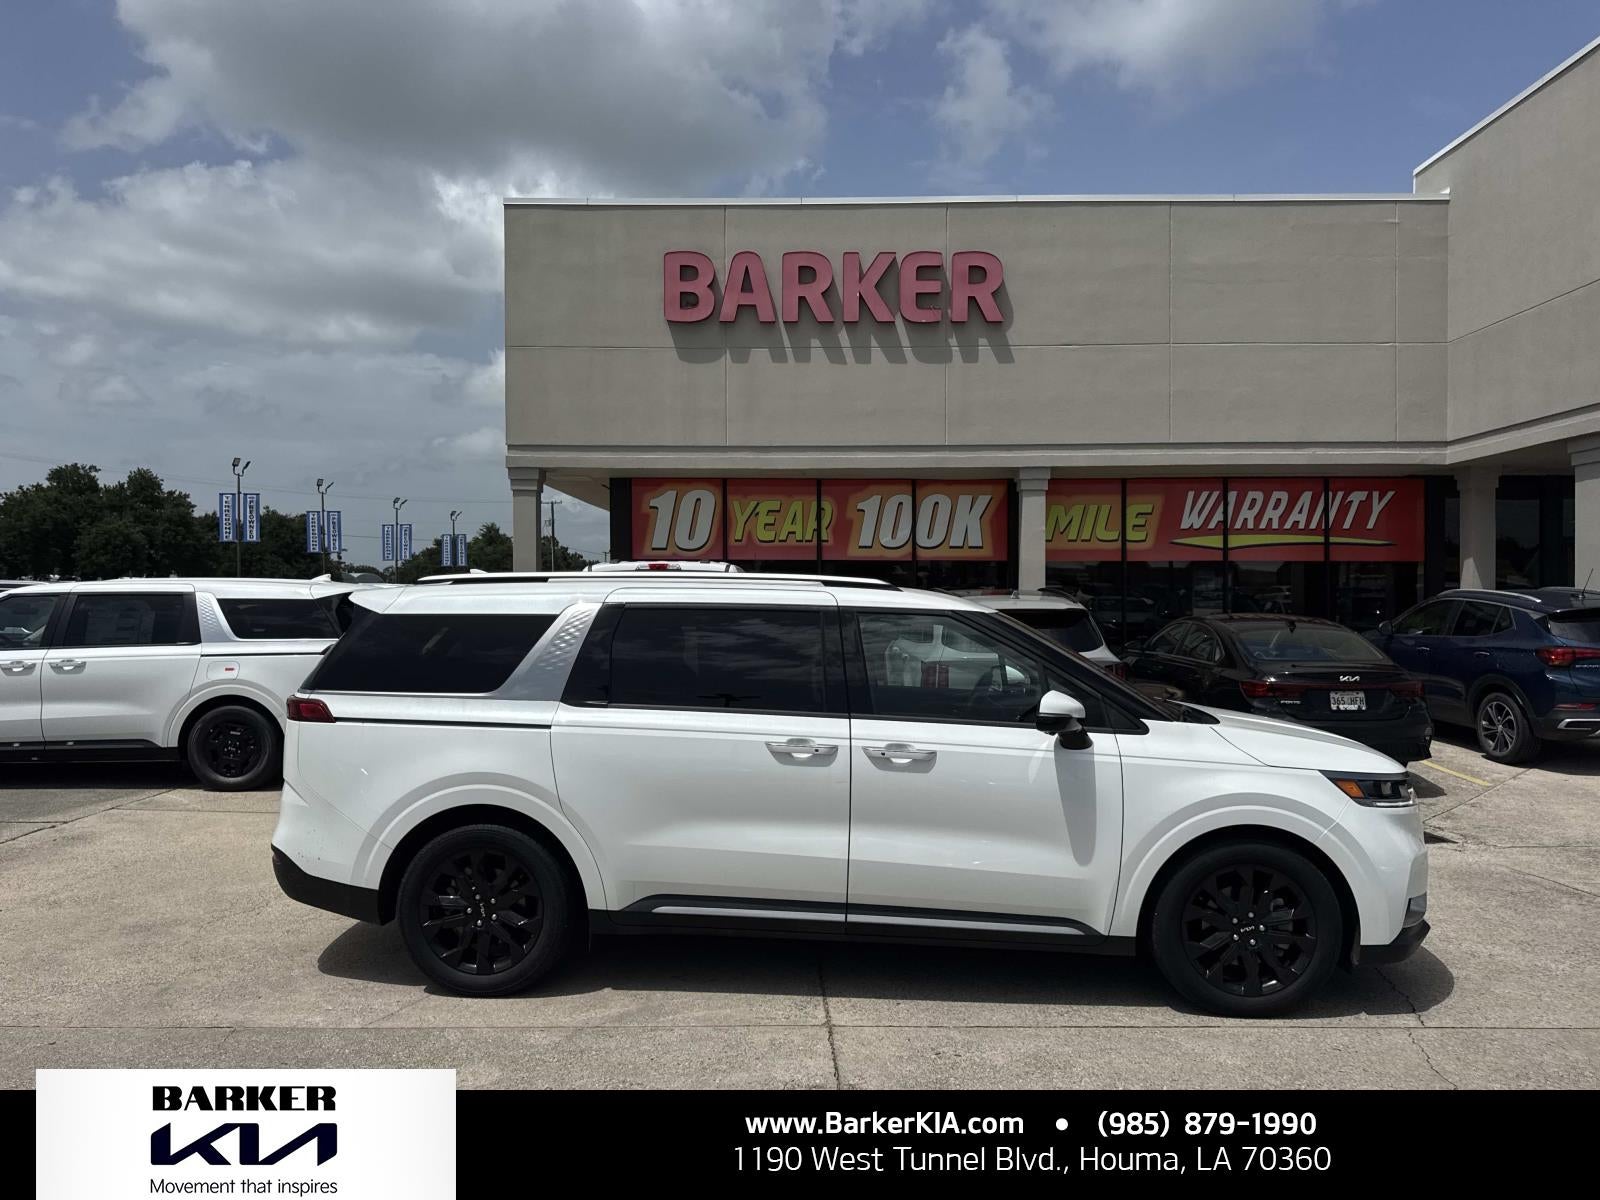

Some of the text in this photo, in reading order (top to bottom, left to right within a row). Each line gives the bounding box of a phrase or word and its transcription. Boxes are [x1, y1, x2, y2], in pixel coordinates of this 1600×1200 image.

[664, 251, 1004, 323] BARKER
[650, 490, 1396, 550] 10 YEAR 100K MILE WARRANTY
[1331, 697, 1345, 705] 365
